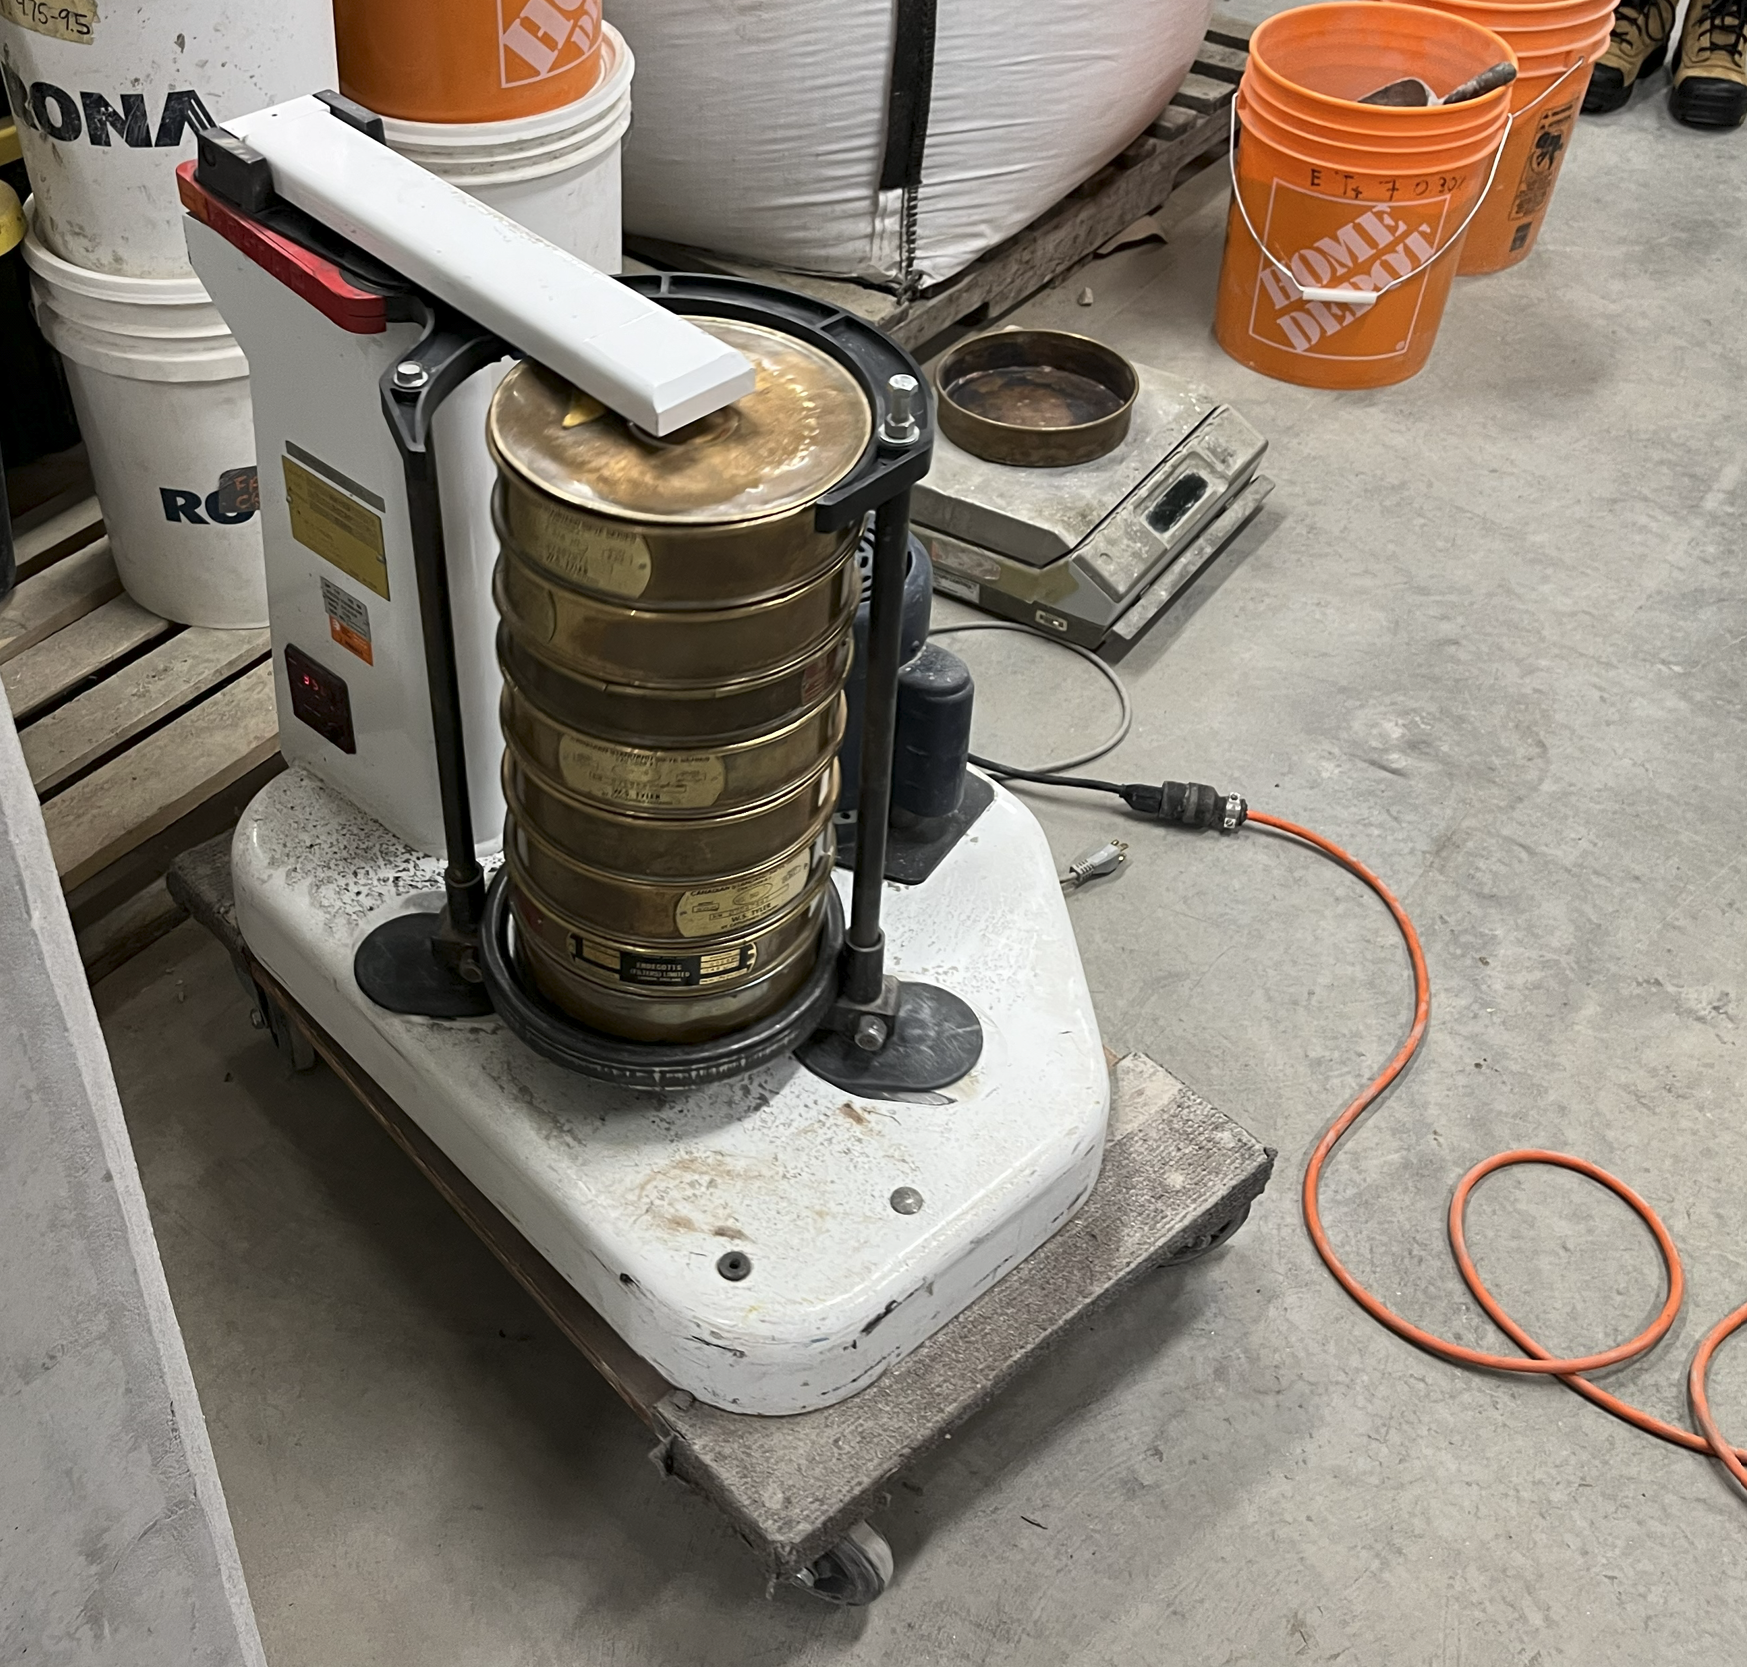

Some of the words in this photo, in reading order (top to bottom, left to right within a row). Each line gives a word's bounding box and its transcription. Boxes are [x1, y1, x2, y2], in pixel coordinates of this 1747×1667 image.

[1310, 168, 1322, 187] E
[1260, 204, 1408, 310] HOME
[1276, 223, 1435, 352] DEPOT
